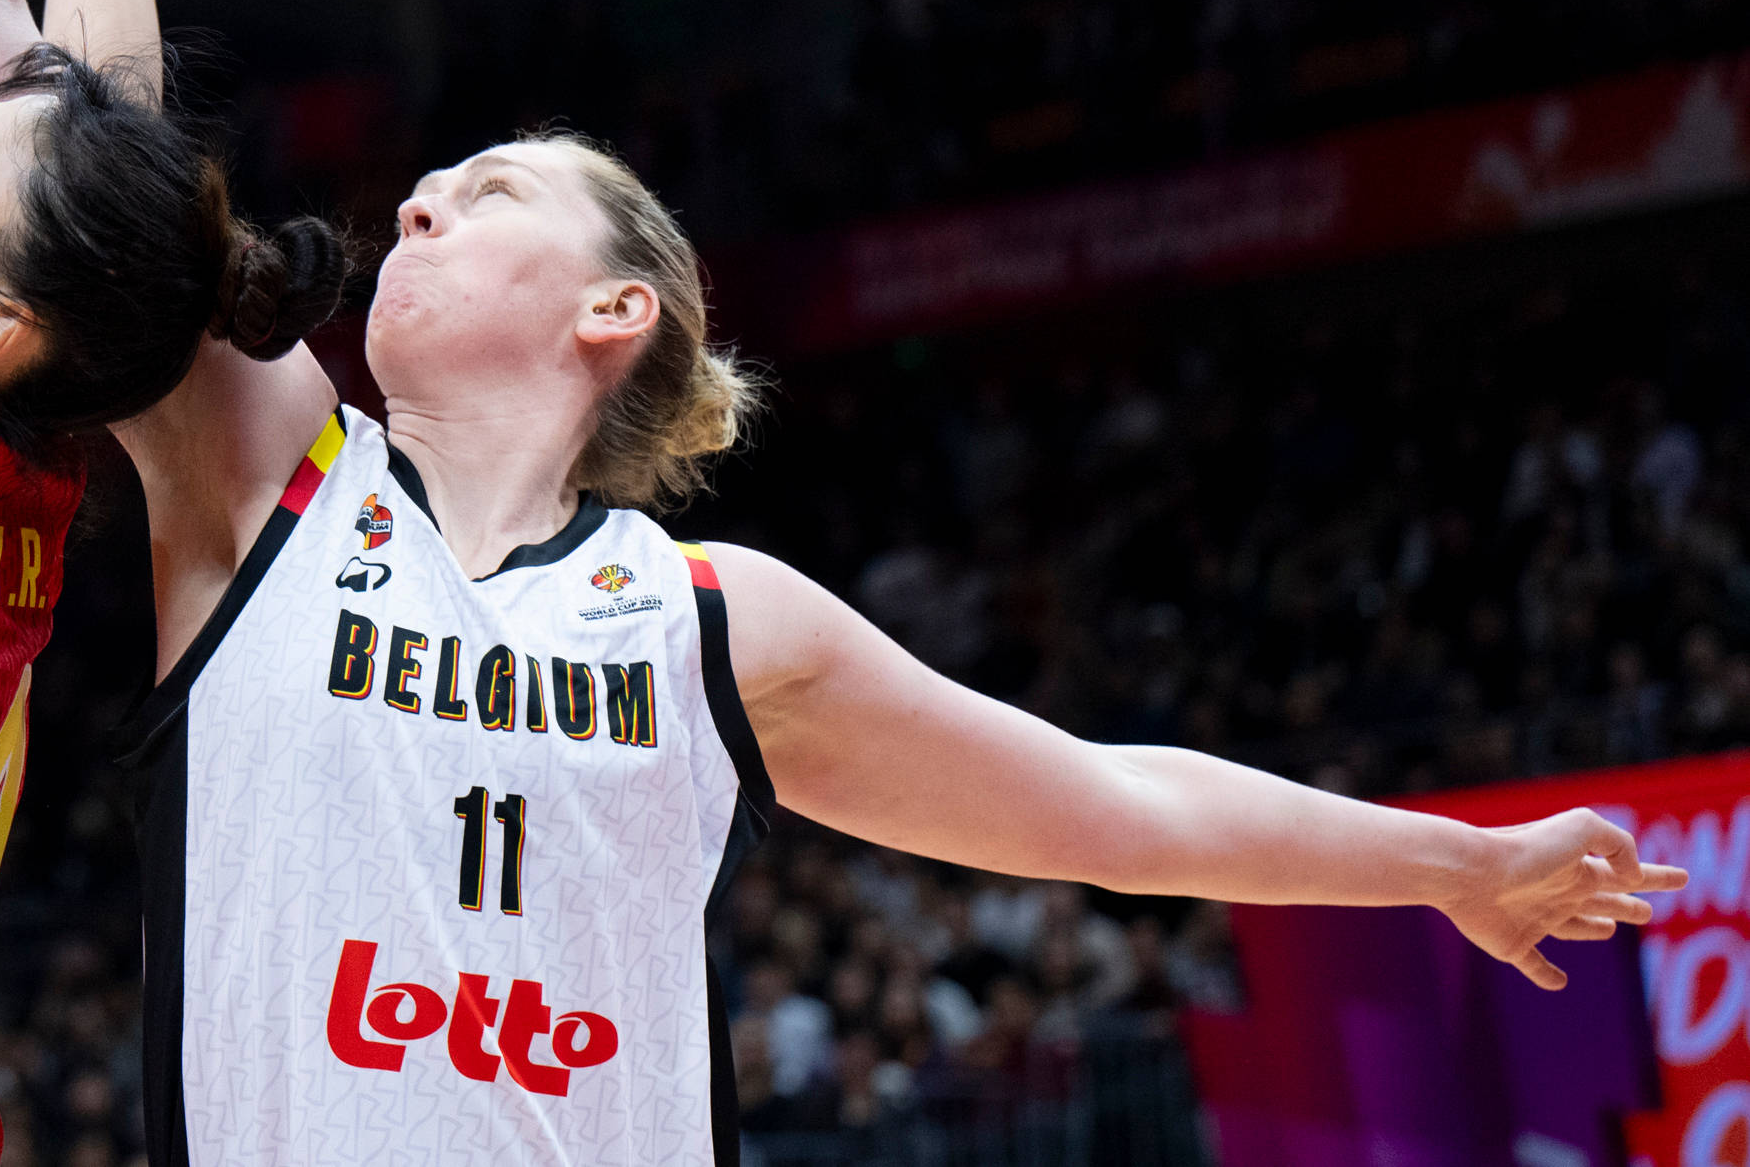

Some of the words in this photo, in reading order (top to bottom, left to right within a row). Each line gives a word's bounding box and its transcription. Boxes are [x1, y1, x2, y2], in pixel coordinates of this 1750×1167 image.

[578, 607, 616, 617] WORLD
[617, 601, 637, 611] CUP
[640, 598, 663, 607] 2026
[327, 608, 658, 749] BELGIUM
[454, 786, 526, 916] 11
[327, 939, 619, 1097] Lotto
